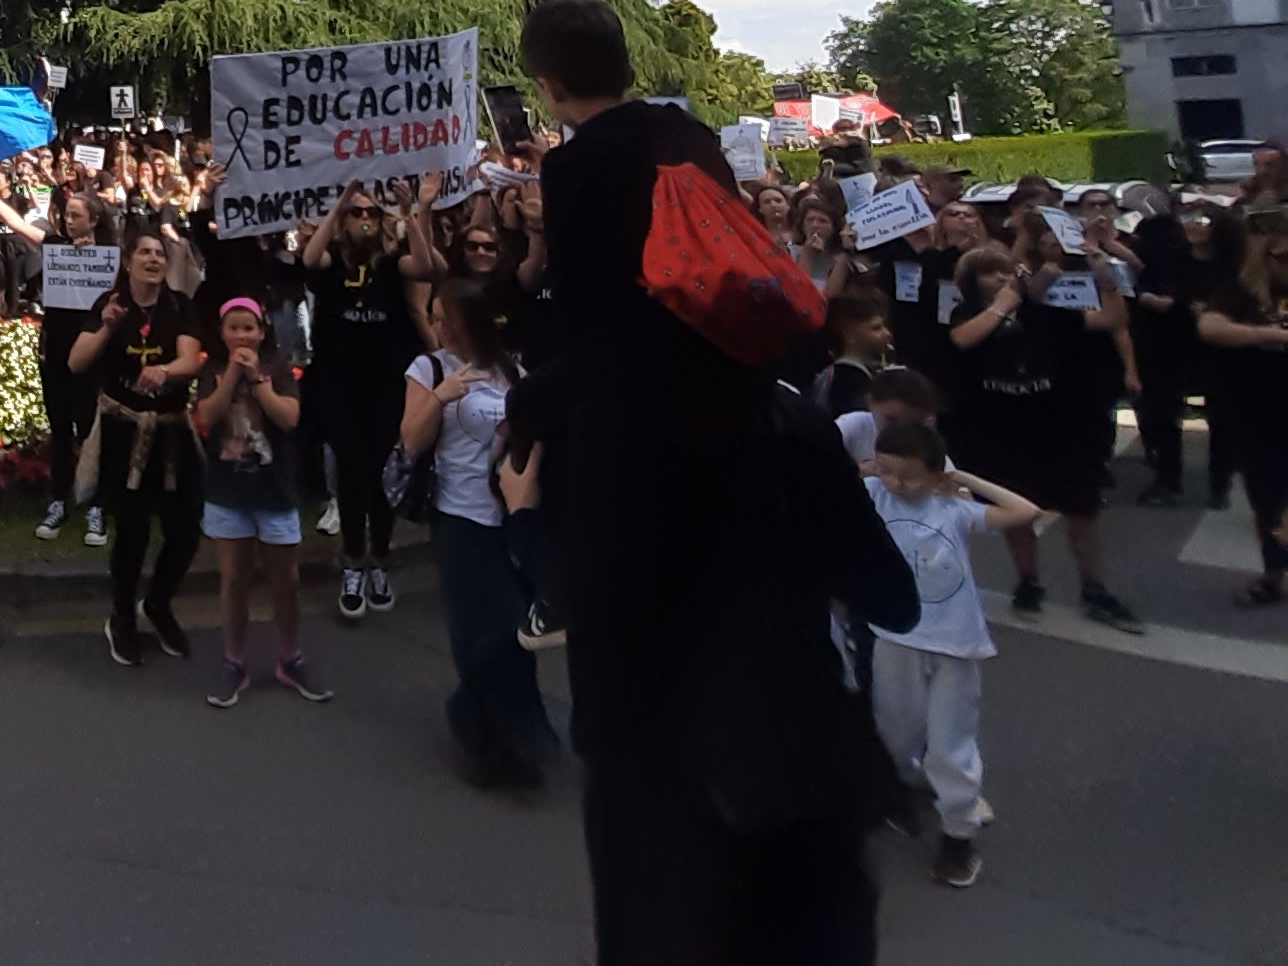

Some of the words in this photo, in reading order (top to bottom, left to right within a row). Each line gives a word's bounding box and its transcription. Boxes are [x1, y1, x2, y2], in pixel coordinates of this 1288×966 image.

[281, 51, 348, 87] POR
[384, 41, 441, 76] UNA
[263, 74, 453, 129] EDUCACIÓN
[263, 135, 302, 171] DE
[333, 114, 460, 160] CALIDAD
[373, 166, 461, 206] ASTIAS
